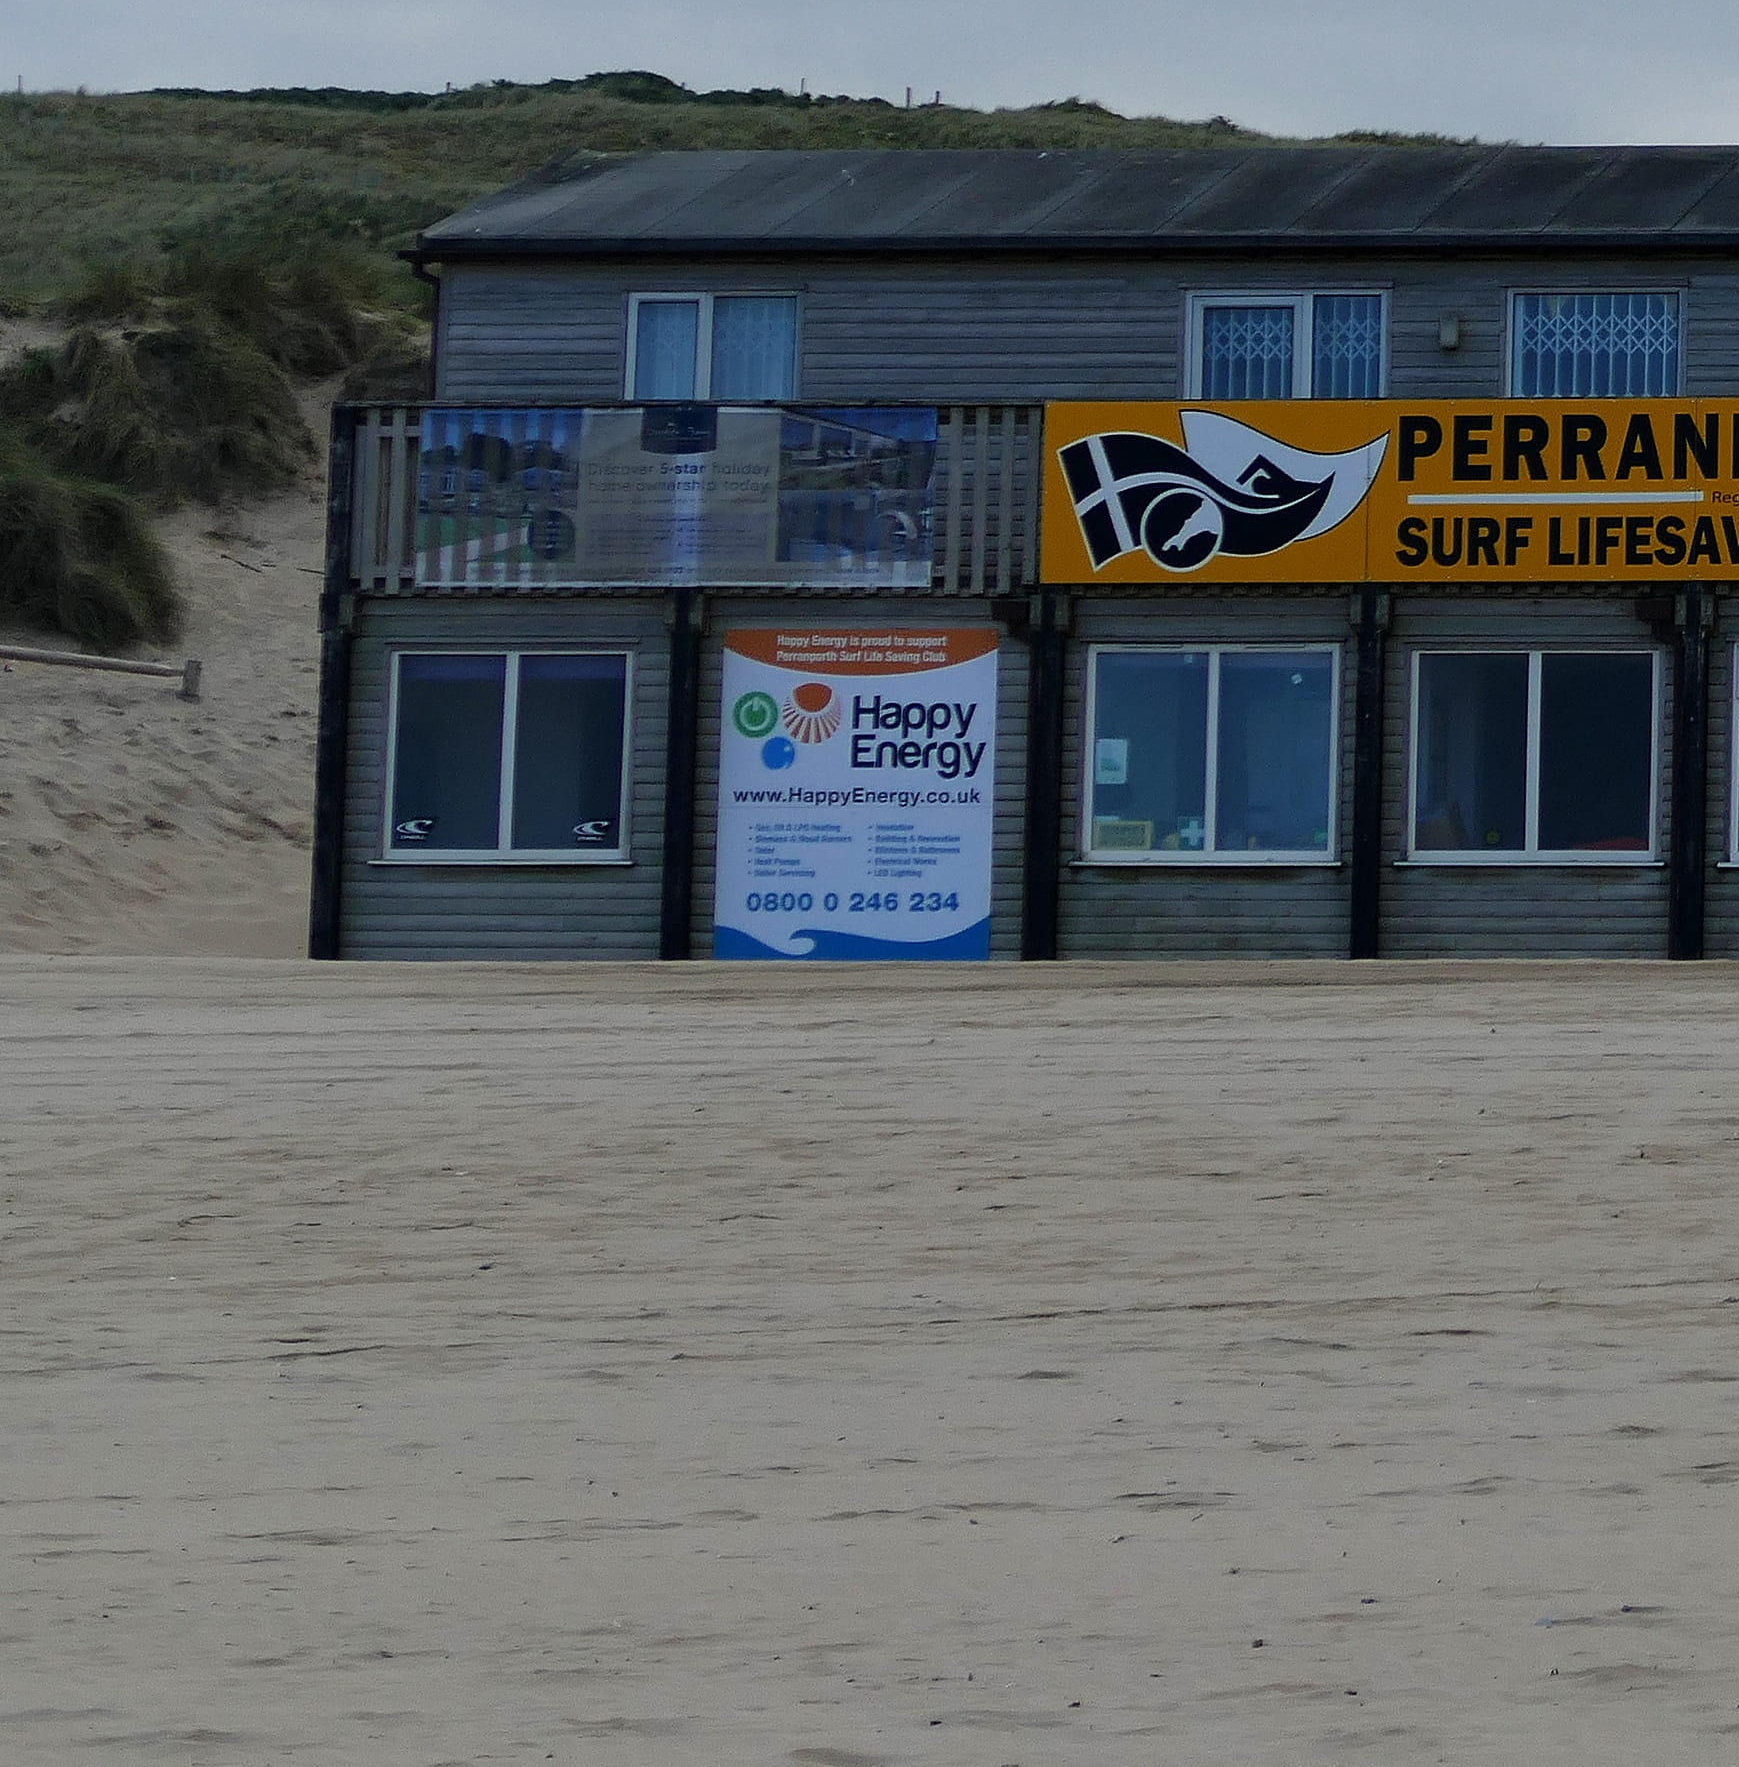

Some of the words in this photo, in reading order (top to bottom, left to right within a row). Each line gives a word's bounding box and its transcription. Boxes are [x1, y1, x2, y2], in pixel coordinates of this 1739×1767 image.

[660, 462, 706, 476] 5-star
[1394, 515, 1533, 567] SURF
[777, 635, 808, 648] Happy
[811, 635, 848, 648] Energy
[850, 635, 860, 646] is
[861, 635, 892, 648] proud
[894, 635, 904, 646] to
[906, 635, 948, 648] support
[839, 650, 860, 662] Surf
[863, 650, 883, 662] Life
[885, 650, 920, 664] Saving
[922, 650, 946, 662] Club
[851, 694, 978, 739] Happy
[850, 733, 987, 780] Energy
[733, 786, 981, 807] www.HappyEnergy.co.uk
[747, 892, 813, 912] 0800
[823, 892, 839, 912] 0
[848, 892, 899, 912] 246
[908, 892, 960, 912] 234
